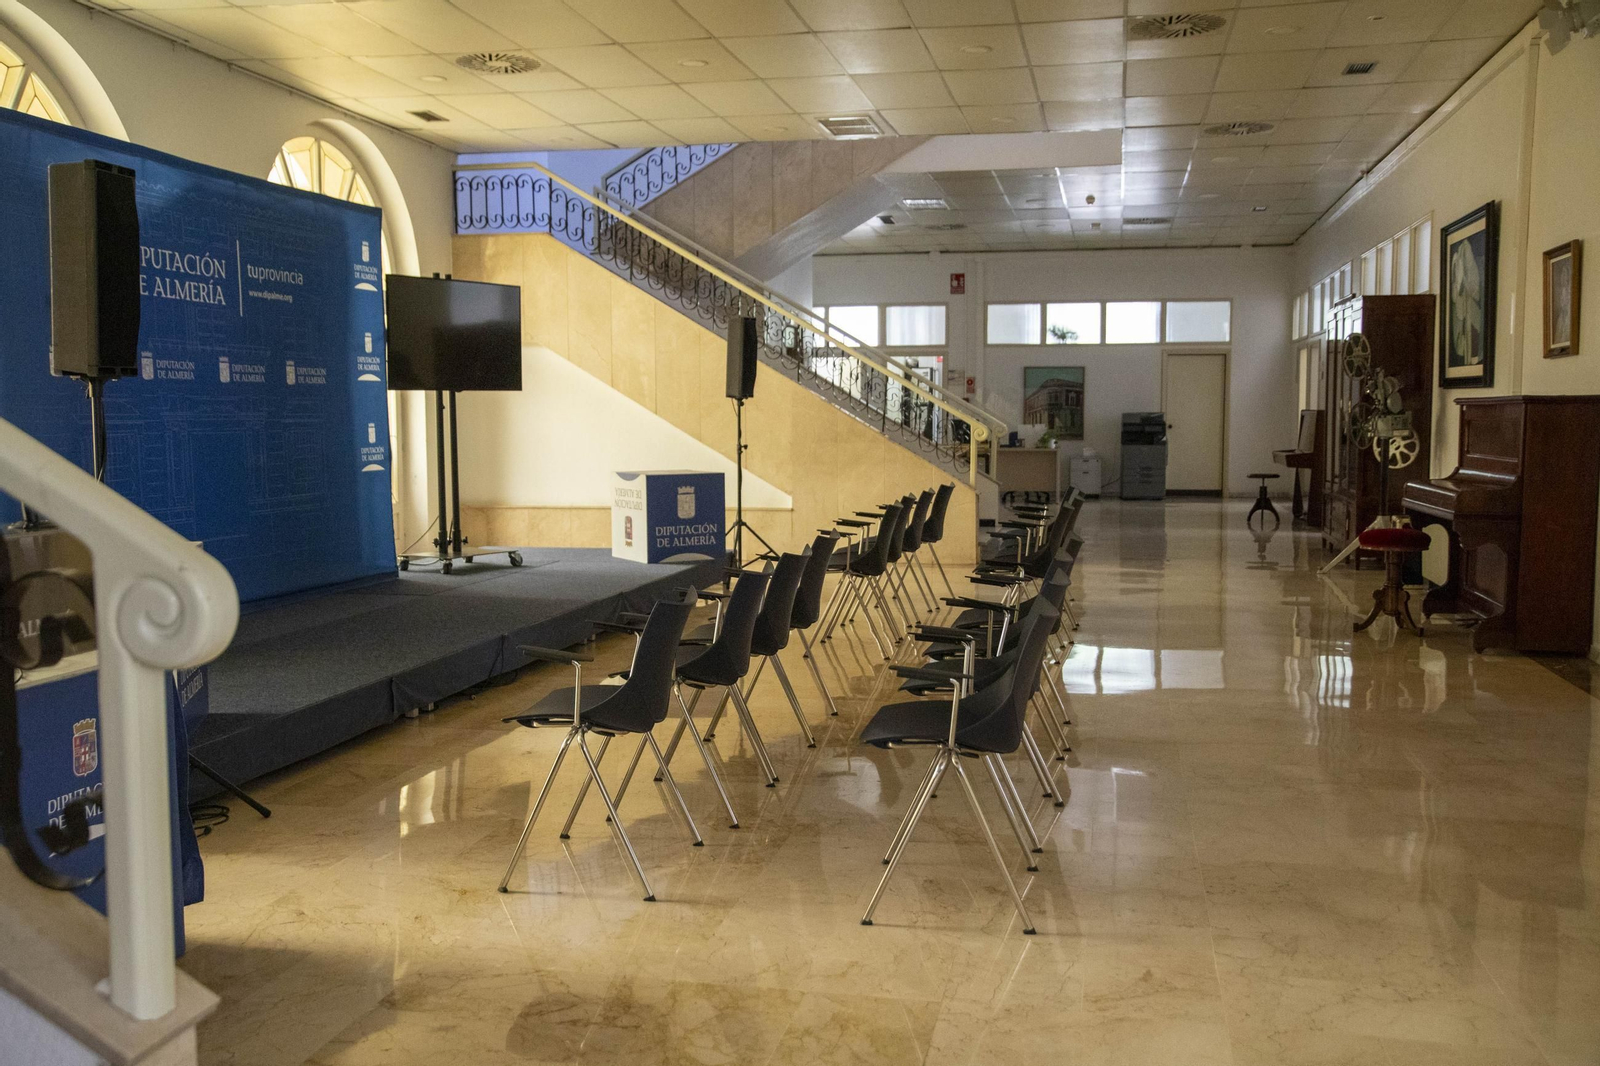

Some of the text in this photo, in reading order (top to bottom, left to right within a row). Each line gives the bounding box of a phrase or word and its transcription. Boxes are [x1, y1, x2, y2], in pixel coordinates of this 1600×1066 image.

[140, 246, 226, 279] PUTACIÓN
[153, 277, 226, 306] ALMERÍA
[157, 370, 195, 380] DE ALMERÍA
[655, 522, 718, 537] DIPUTACIÓN
[656, 535, 717, 548] DE ALMERÍA
